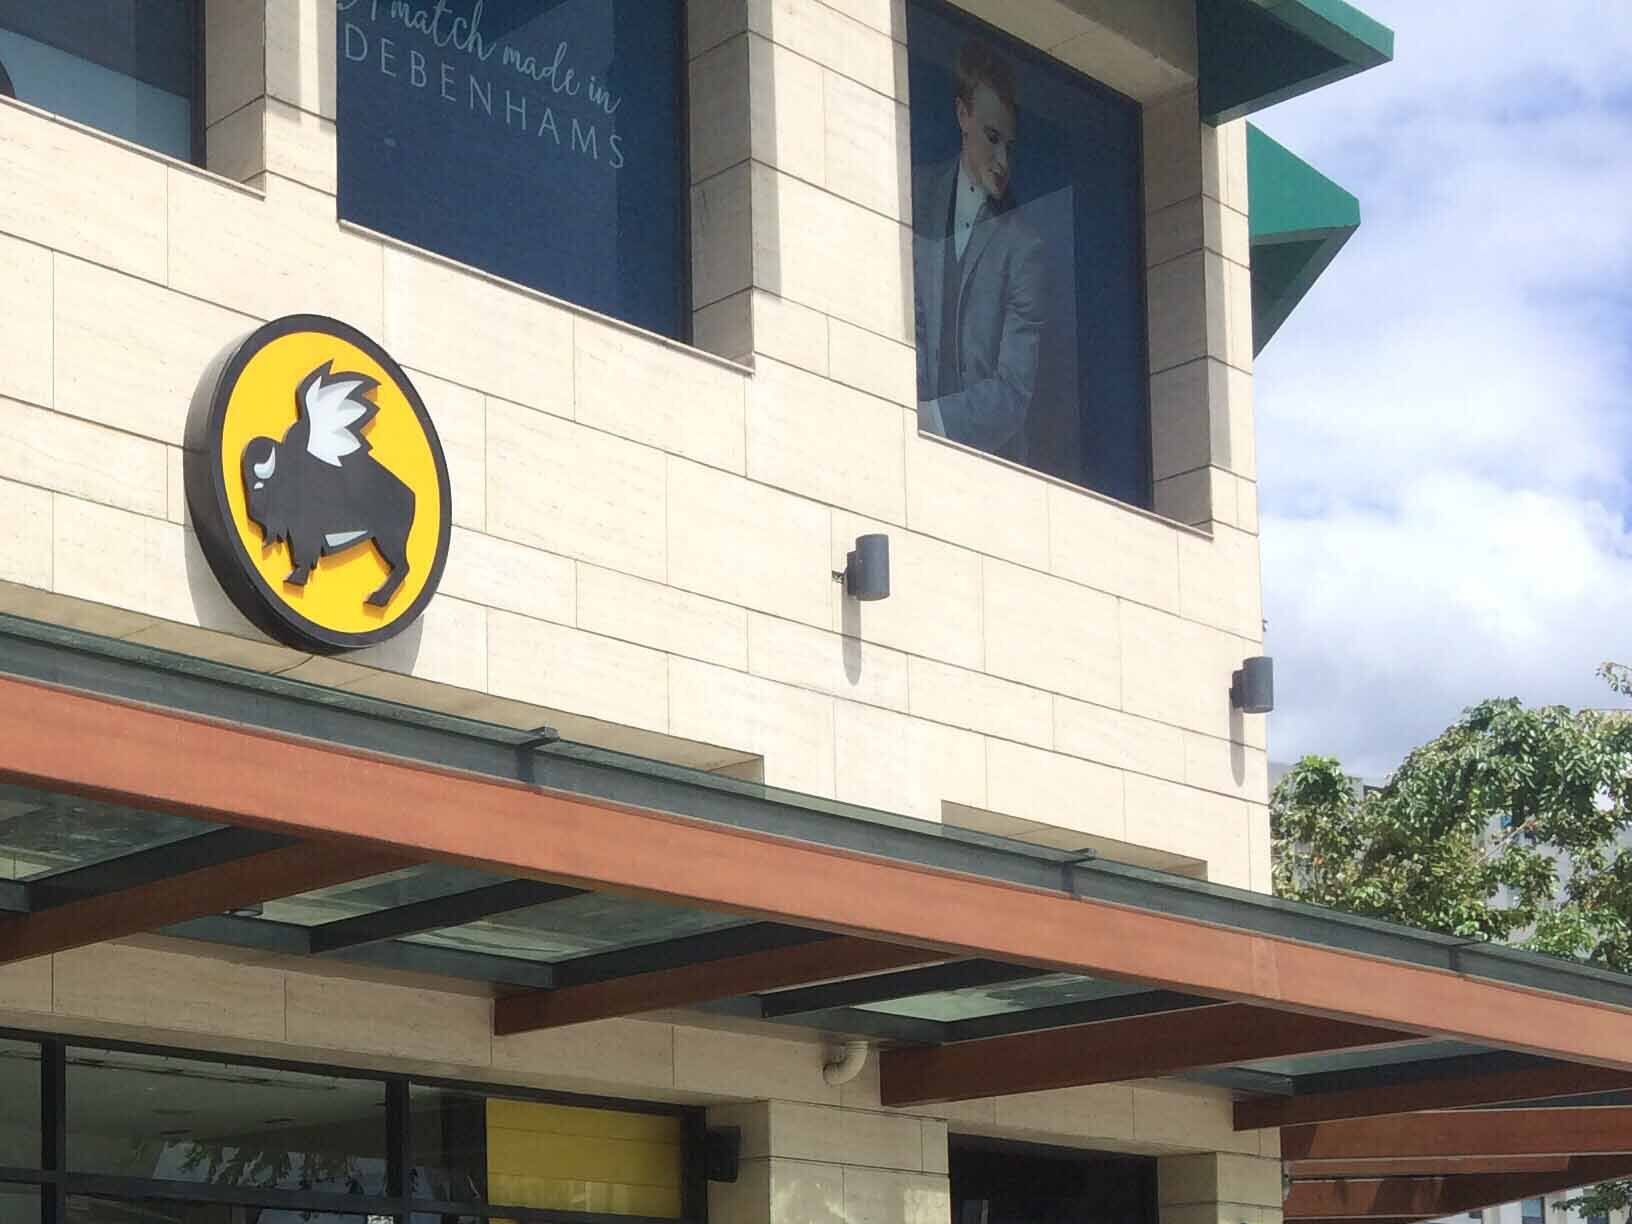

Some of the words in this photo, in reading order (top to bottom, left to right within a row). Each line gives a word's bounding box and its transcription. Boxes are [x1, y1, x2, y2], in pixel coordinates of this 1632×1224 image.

[344, 23, 625, 169] DEBENHAMS
[391, 0, 497, 61] match
[503, 42, 578, 96] made
[589, 75, 621, 115] in
